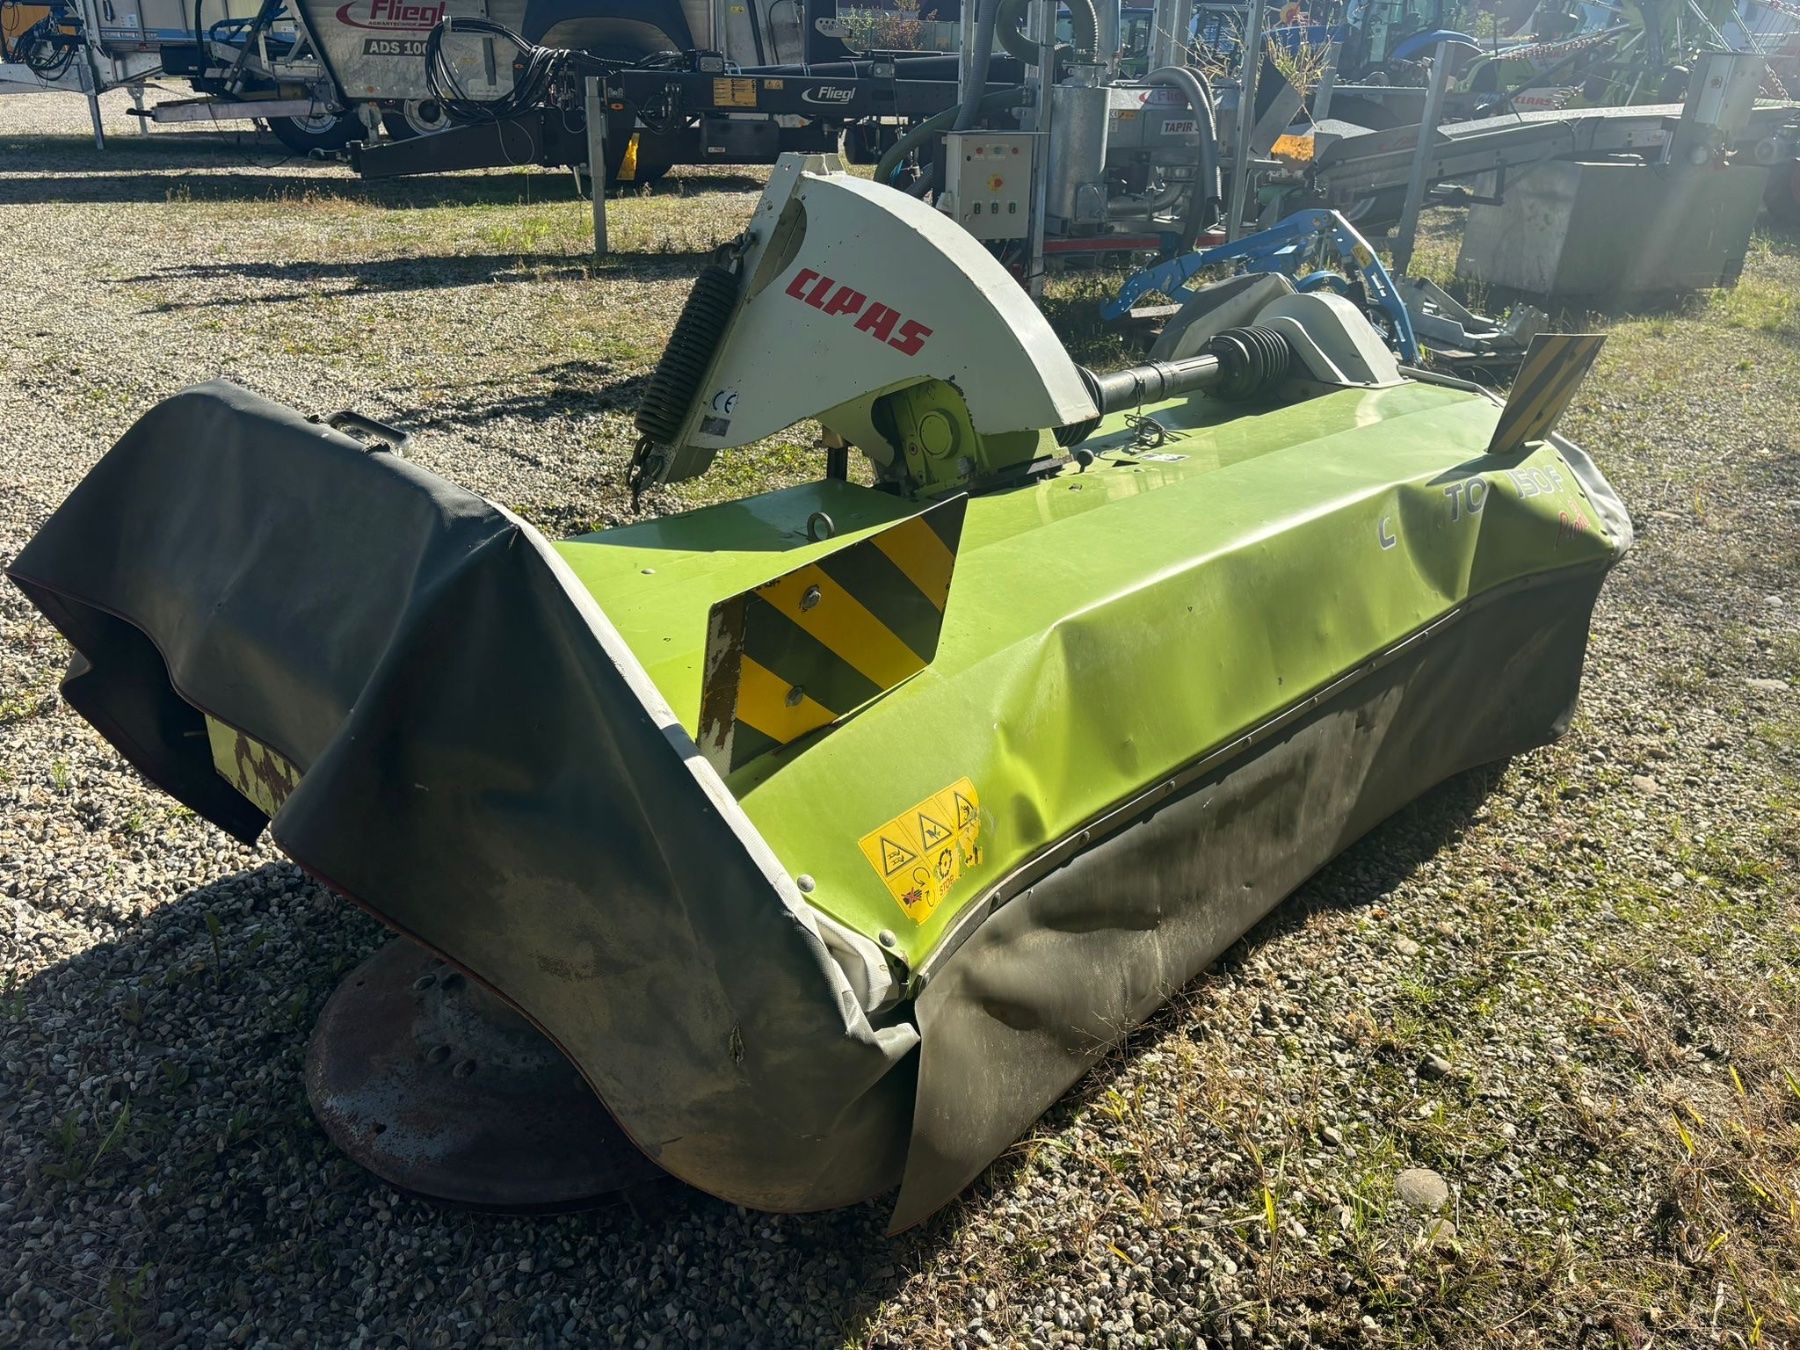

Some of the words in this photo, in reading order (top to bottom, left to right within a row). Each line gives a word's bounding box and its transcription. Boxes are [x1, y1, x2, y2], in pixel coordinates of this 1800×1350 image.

[370, 0, 446, 26] Fliegl
[369, 41, 400, 54] ADS
[817, 86, 857, 102] Fliegl
[1164, 122, 1193, 132] TAPIR
